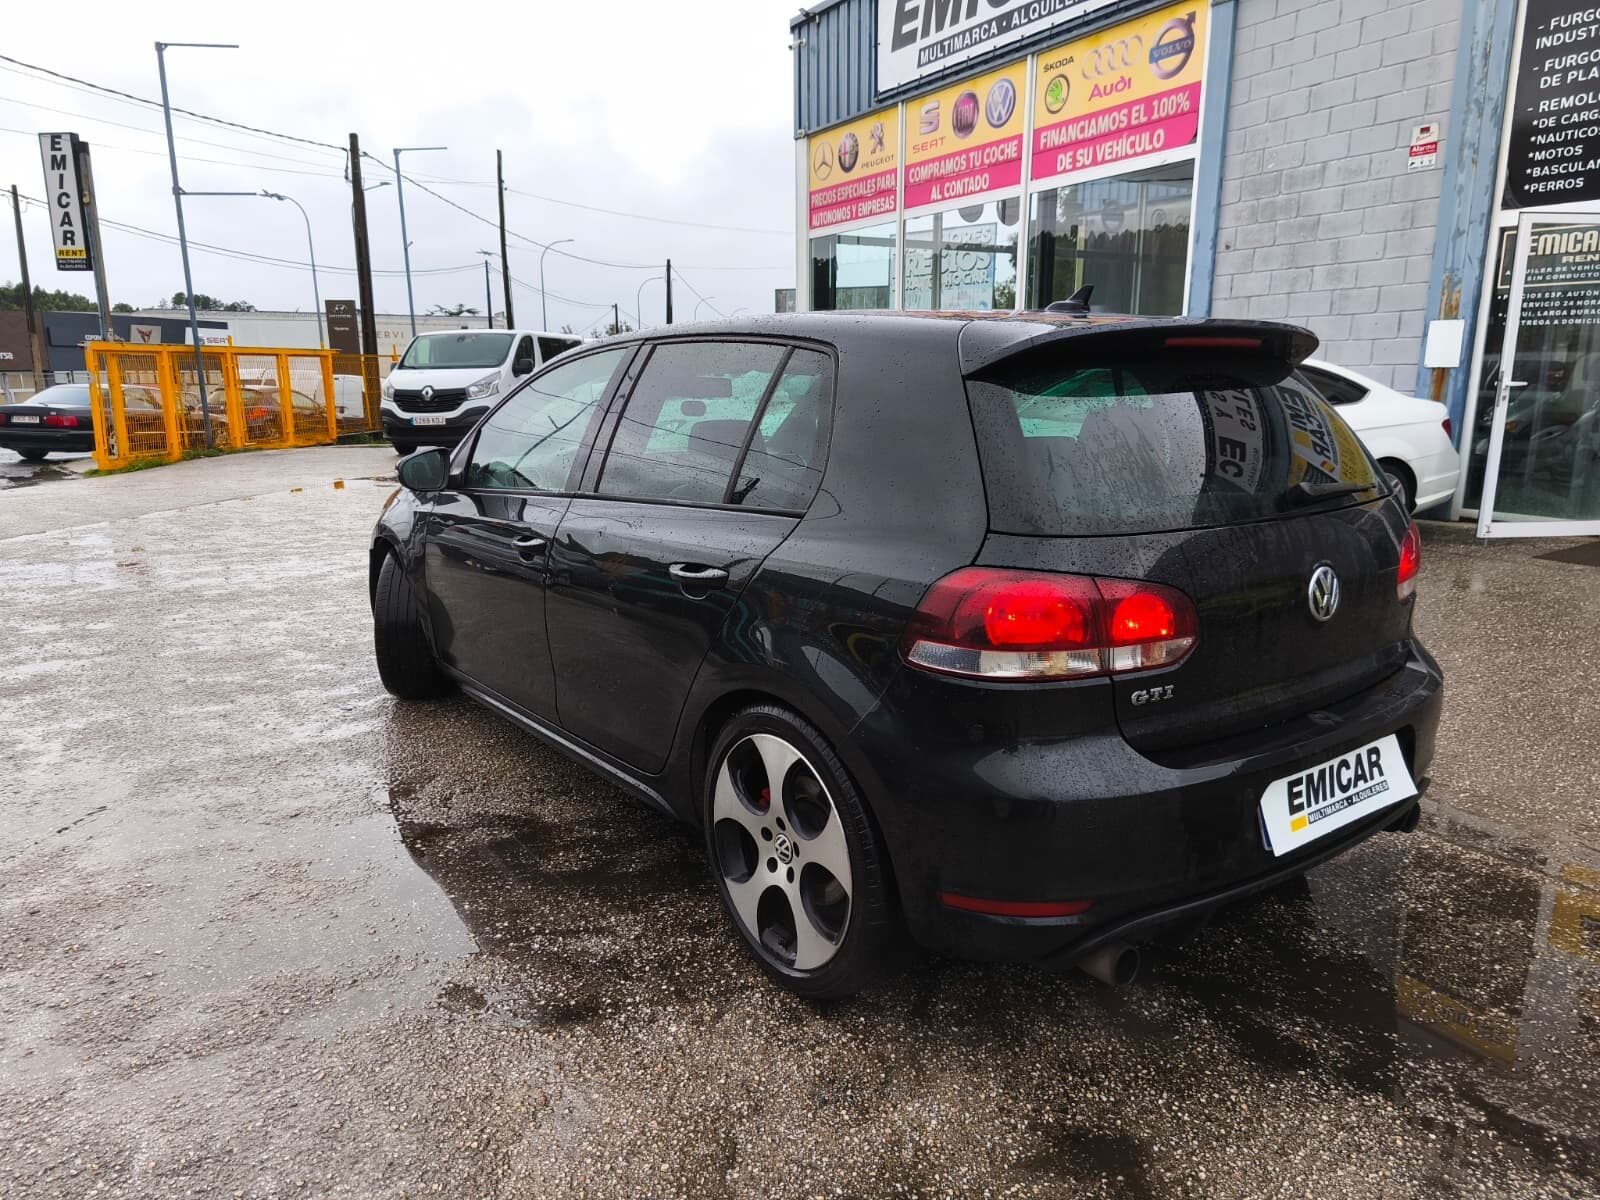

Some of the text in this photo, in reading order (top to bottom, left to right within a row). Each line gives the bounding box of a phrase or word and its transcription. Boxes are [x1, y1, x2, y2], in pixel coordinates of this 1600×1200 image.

[920, 21, 998, 65] MULTIMARCA
[1152, 39, 1192, 58] VOLVO
[1536, 24, 1600, 50] INDUST
[1043, 56, 1075, 72] ŠKODA
[1088, 76, 1132, 101] Audi
[1540, 66, 1600, 89] DE PLA
[1539, 92, 1600, 112] REMOL
[1040, 91, 1190, 150] FINANCIAMOS EL 100%
[1561, 109, 1600, 124] CARG
[912, 136, 946, 154] SEAT
[1056, 128, 1165, 172] DE SU VEHÍCULO
[909, 140, 1018, 183] COMPRAMOS TU COCHE
[50, 135, 76, 246] EMICAR
[811, 173, 896, 208] PRECIOS ESPECIALES PARA
[930, 173, 990, 200] AL CONTADO
[852, 204, 858, 218] Y
[858, 195, 895, 216] EMPRESAS
[1528, 230, 1600, 256] EMICA
[1131, 684, 1174, 706] GTI
[1287, 746, 1384, 816] EMICAR
[1309, 781, 1389, 821] MULTIMARCA ALQUILERES
